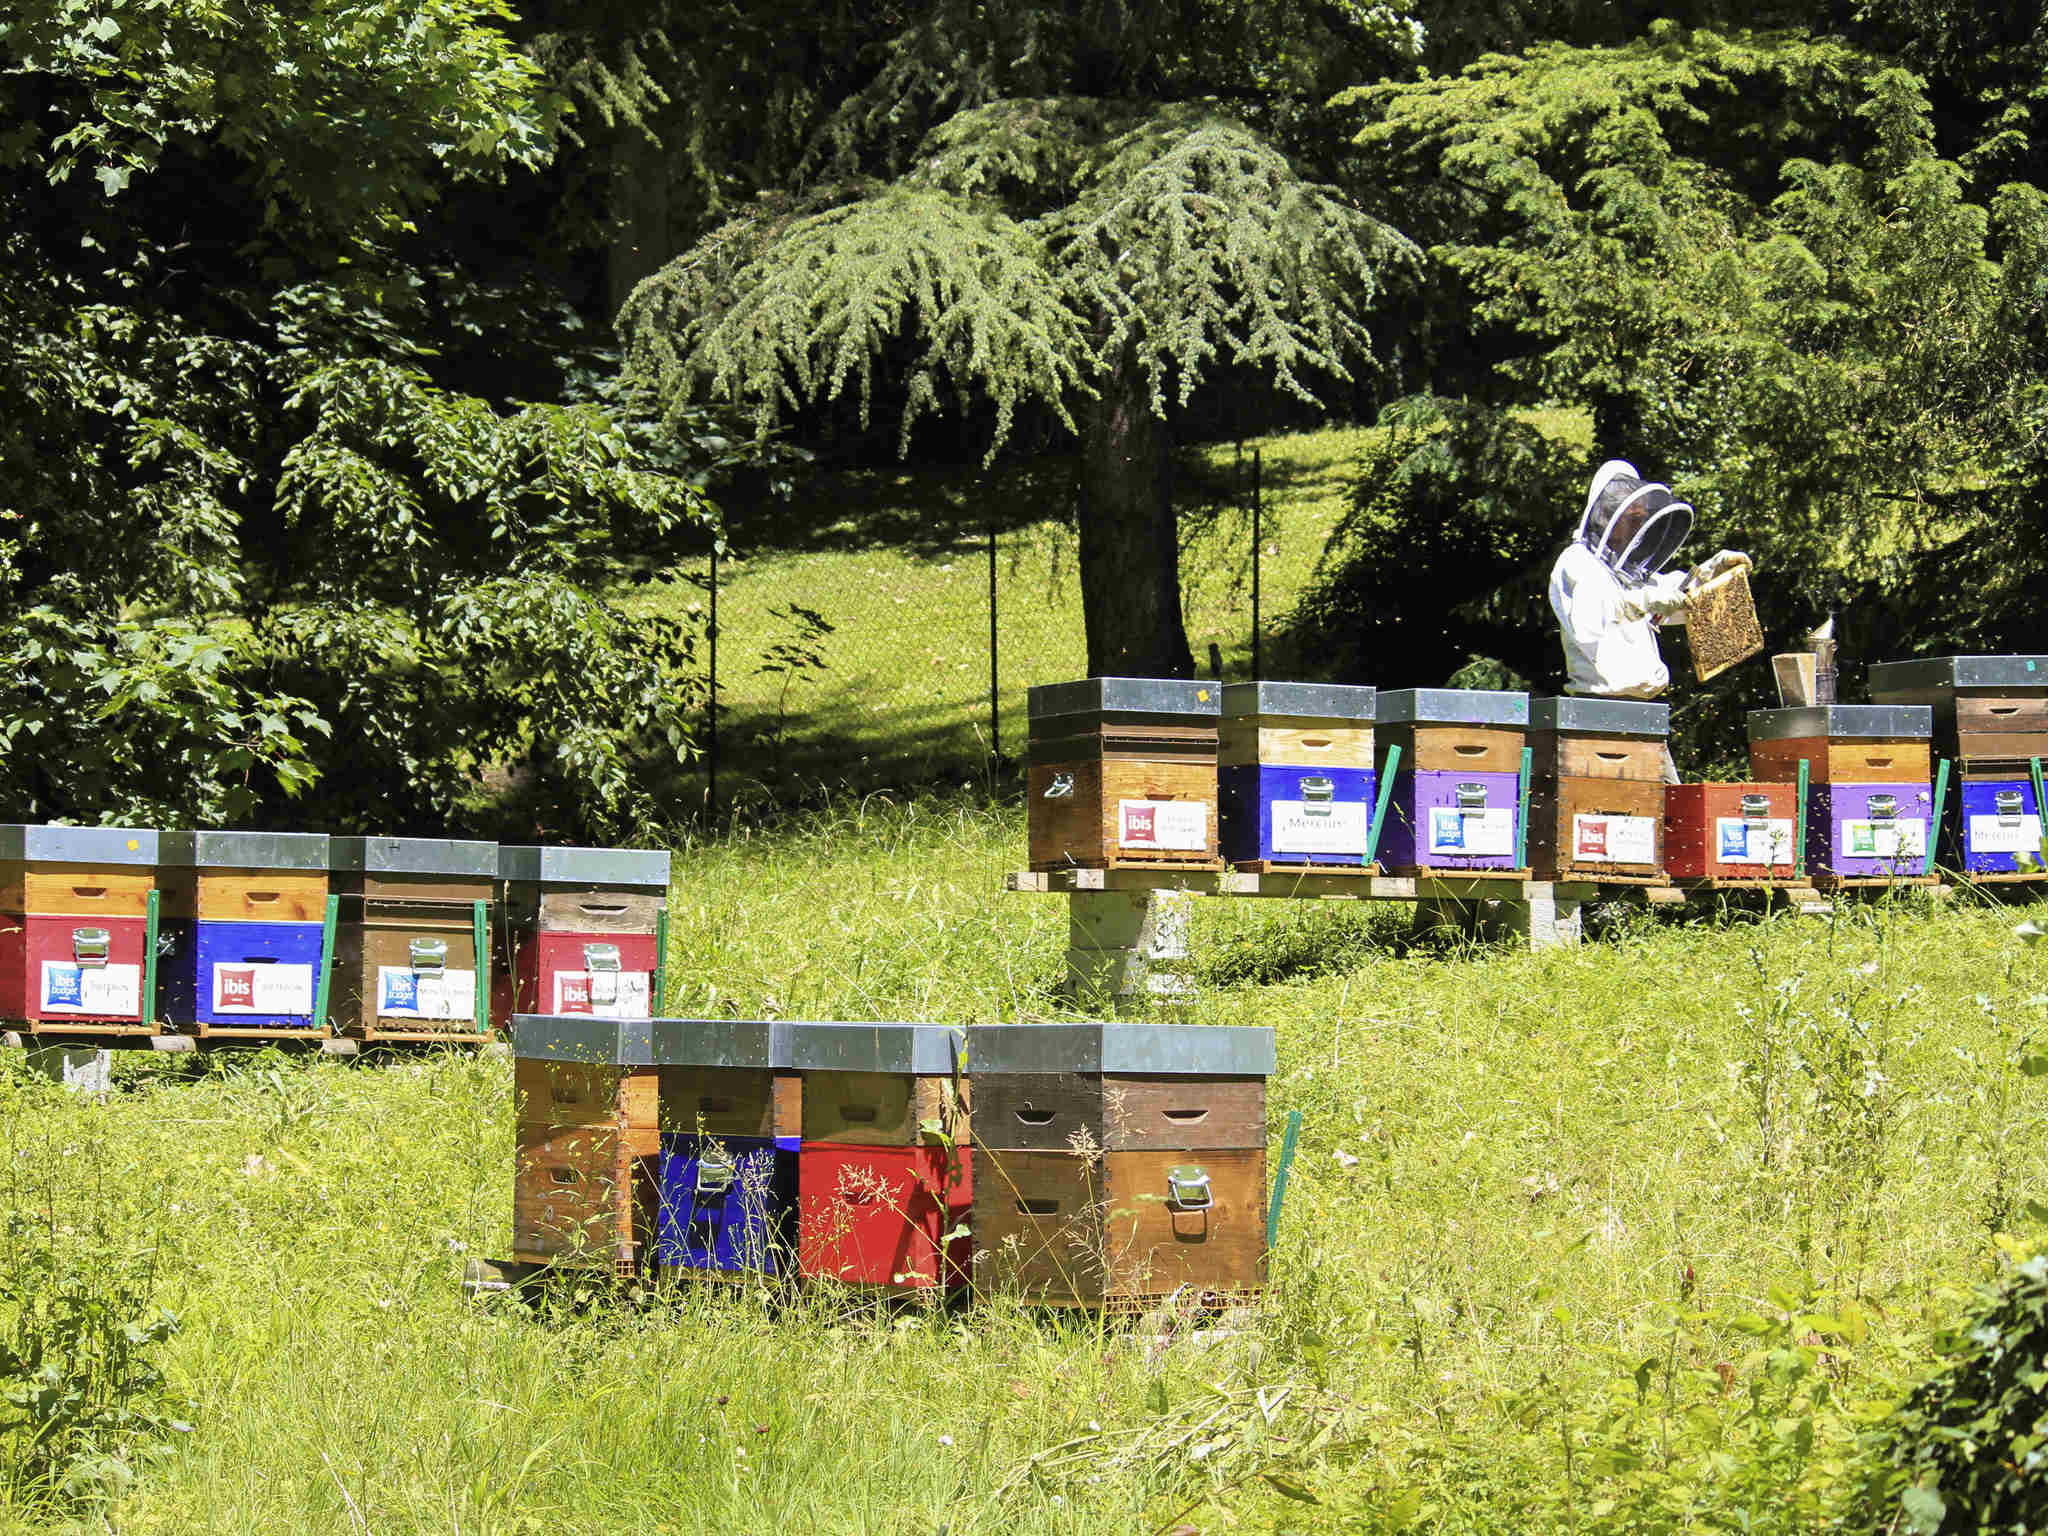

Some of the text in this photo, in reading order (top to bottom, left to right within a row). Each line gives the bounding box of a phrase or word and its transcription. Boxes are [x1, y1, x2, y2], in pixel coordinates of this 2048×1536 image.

[1128, 814, 1152, 830] ibis
[1582, 828, 1603, 844] ibis
[55, 974, 76, 987] ibis
[224, 977, 249, 995] ibis
[563, 985, 588, 1002] ibis
